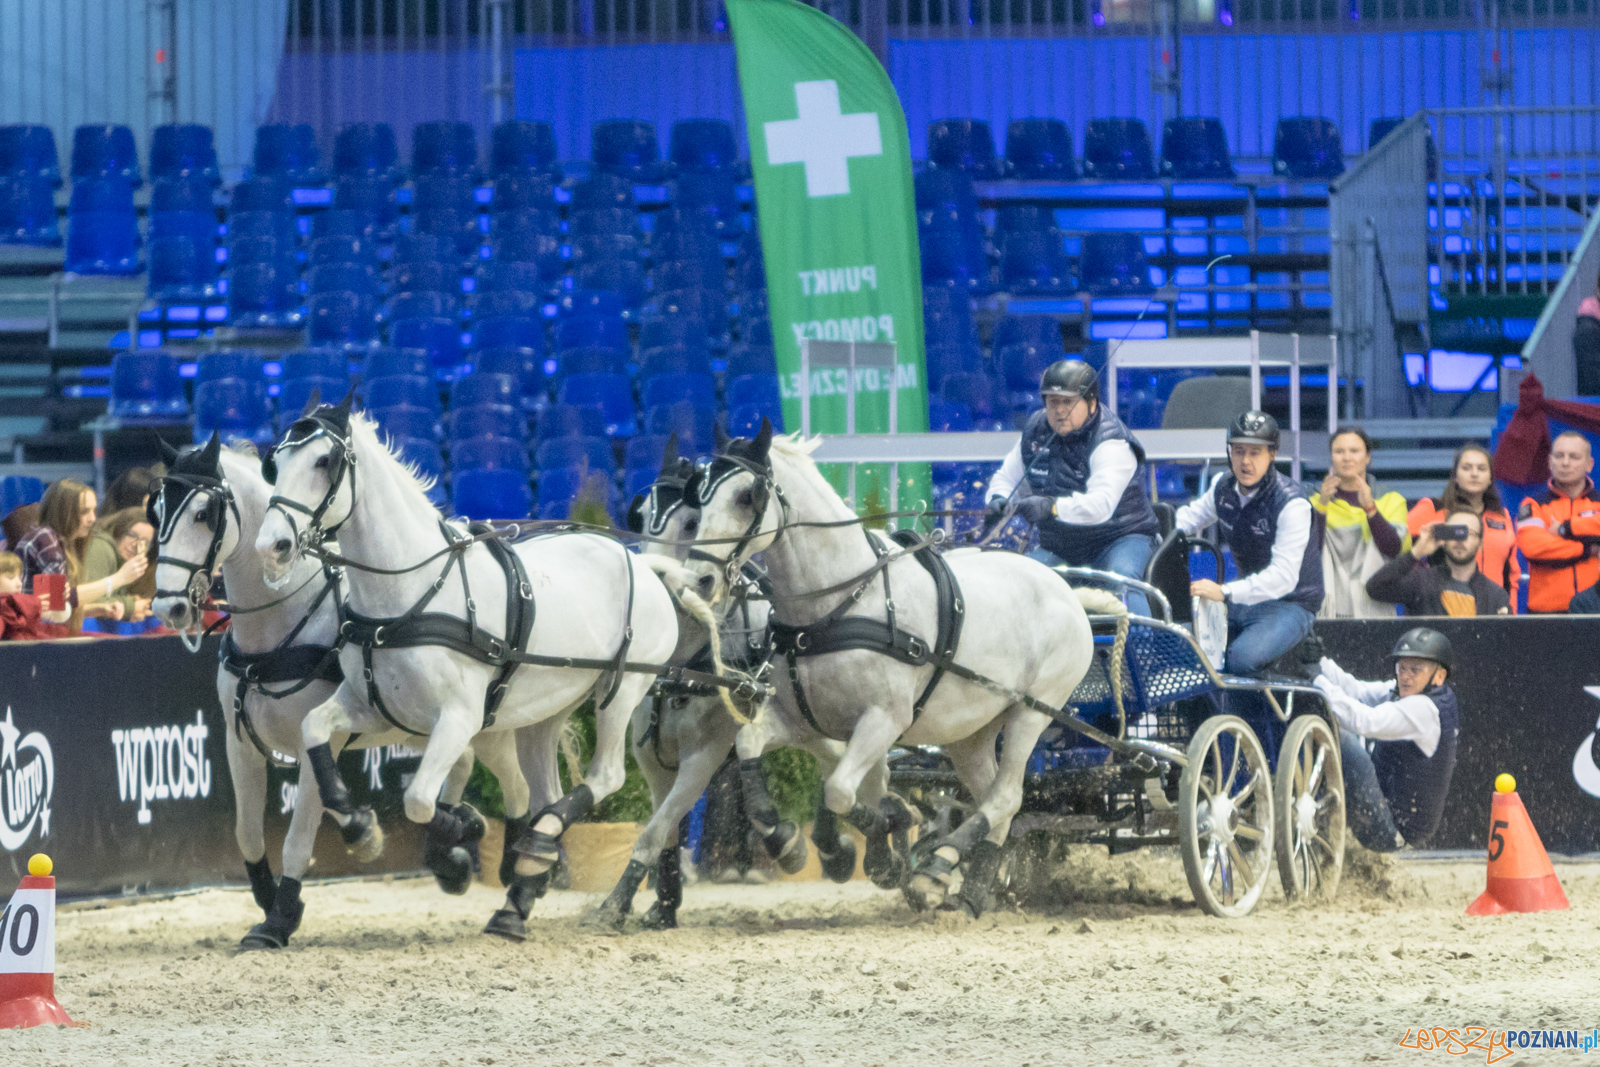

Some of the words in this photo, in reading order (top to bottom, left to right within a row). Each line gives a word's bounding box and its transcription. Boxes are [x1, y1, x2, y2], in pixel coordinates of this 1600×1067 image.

[6, 754, 43, 826] LOTTO
[111, 709, 211, 824] wprost
[1488, 820, 1509, 862] 5
